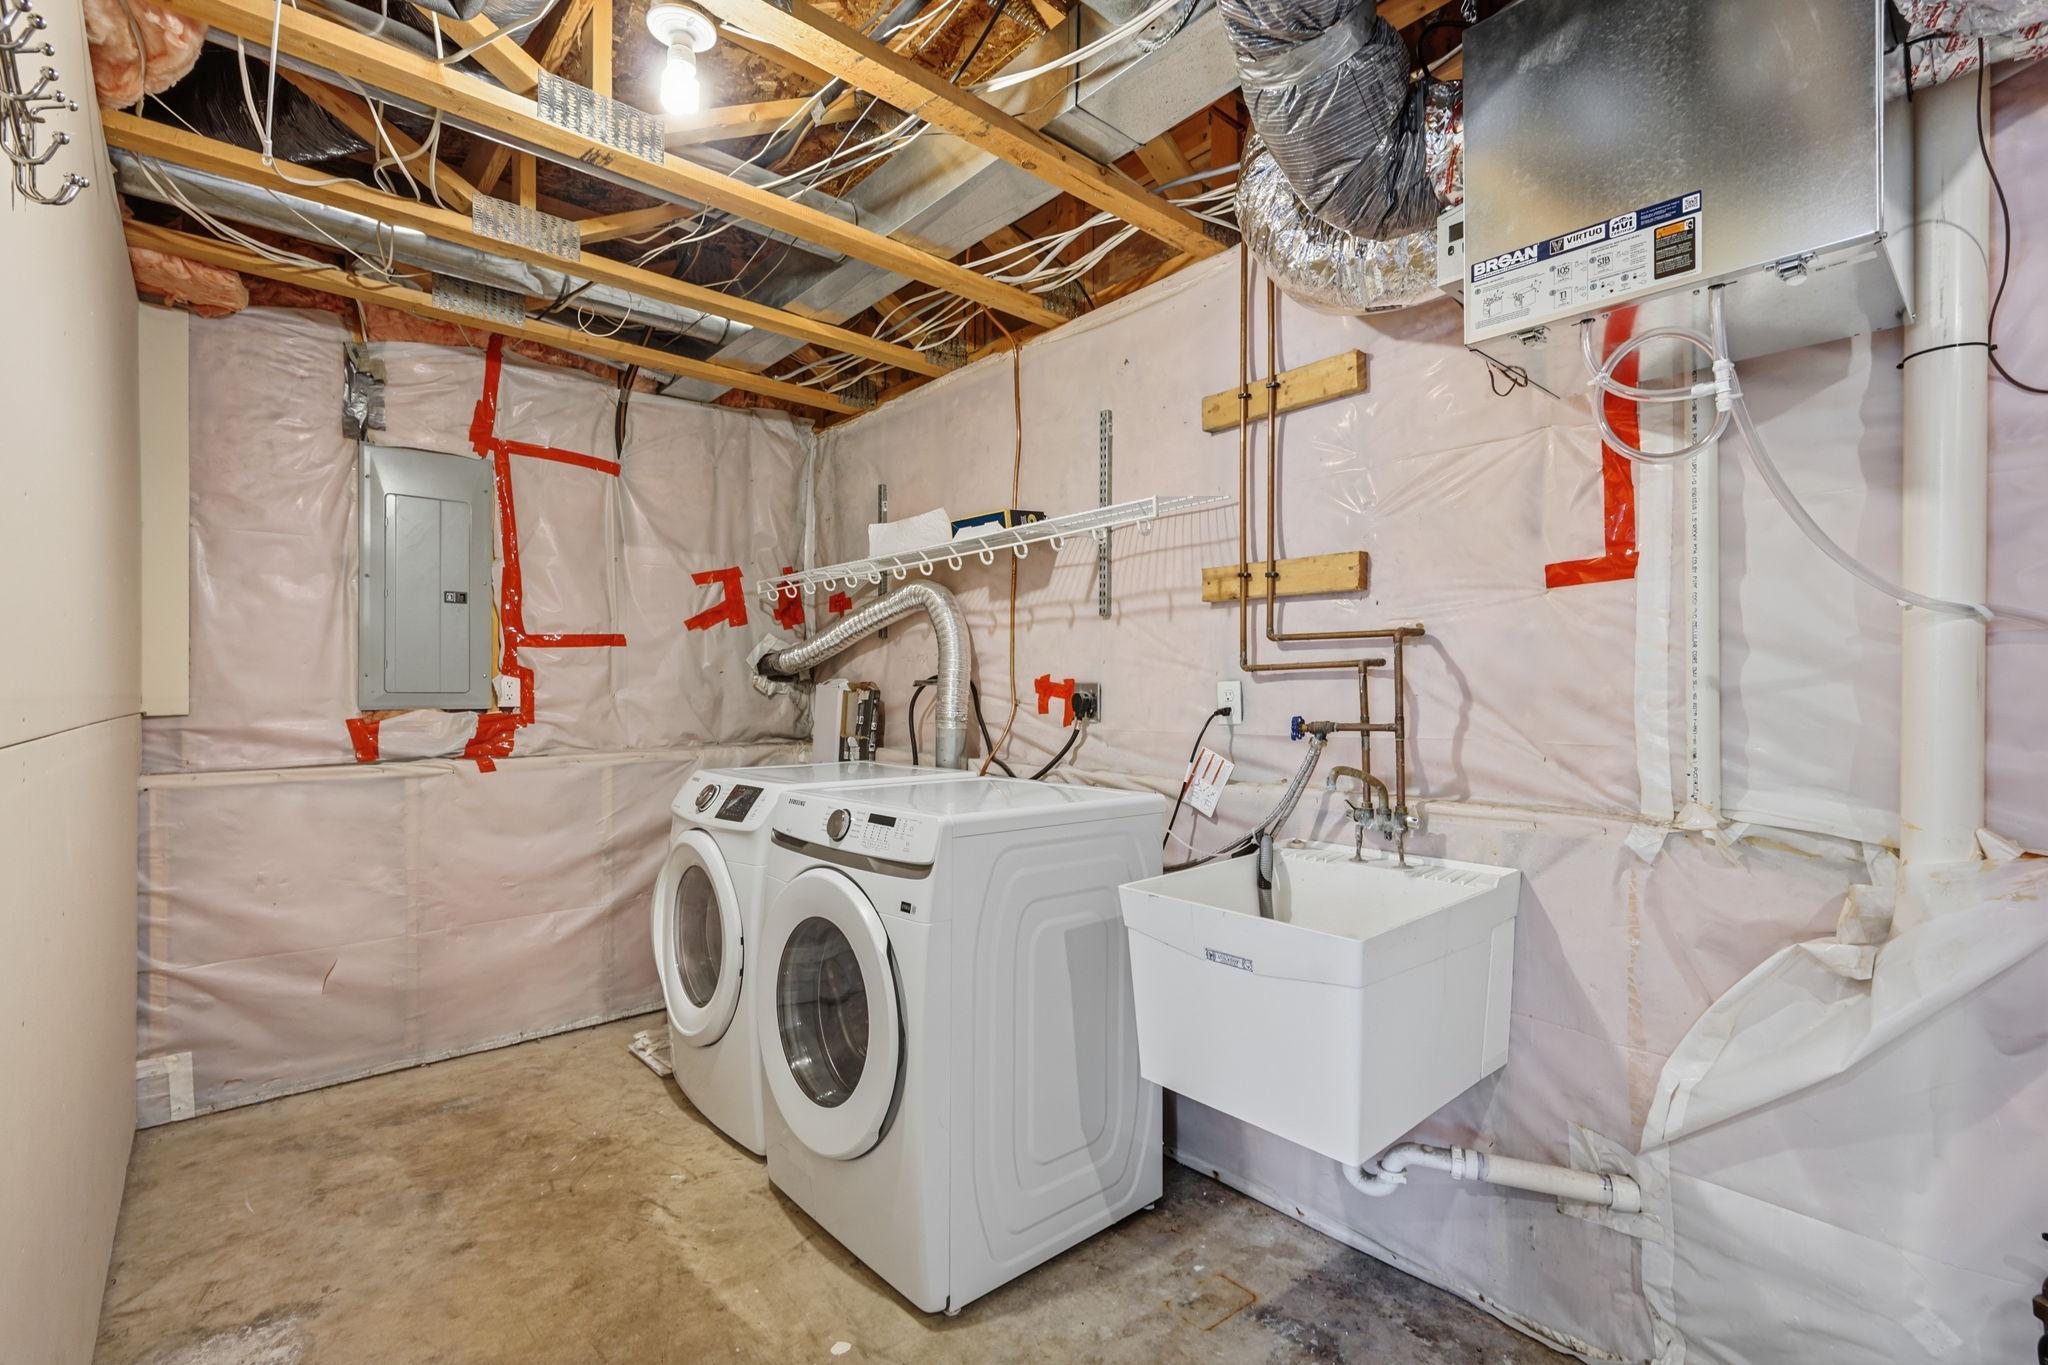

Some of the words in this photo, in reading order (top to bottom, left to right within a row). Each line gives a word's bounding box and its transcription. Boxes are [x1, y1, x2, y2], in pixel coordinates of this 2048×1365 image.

[1611, 220, 1633, 233] HVI
[1566, 227, 1603, 244] VIRTUO
[1473, 244, 1538, 277] BROAN
